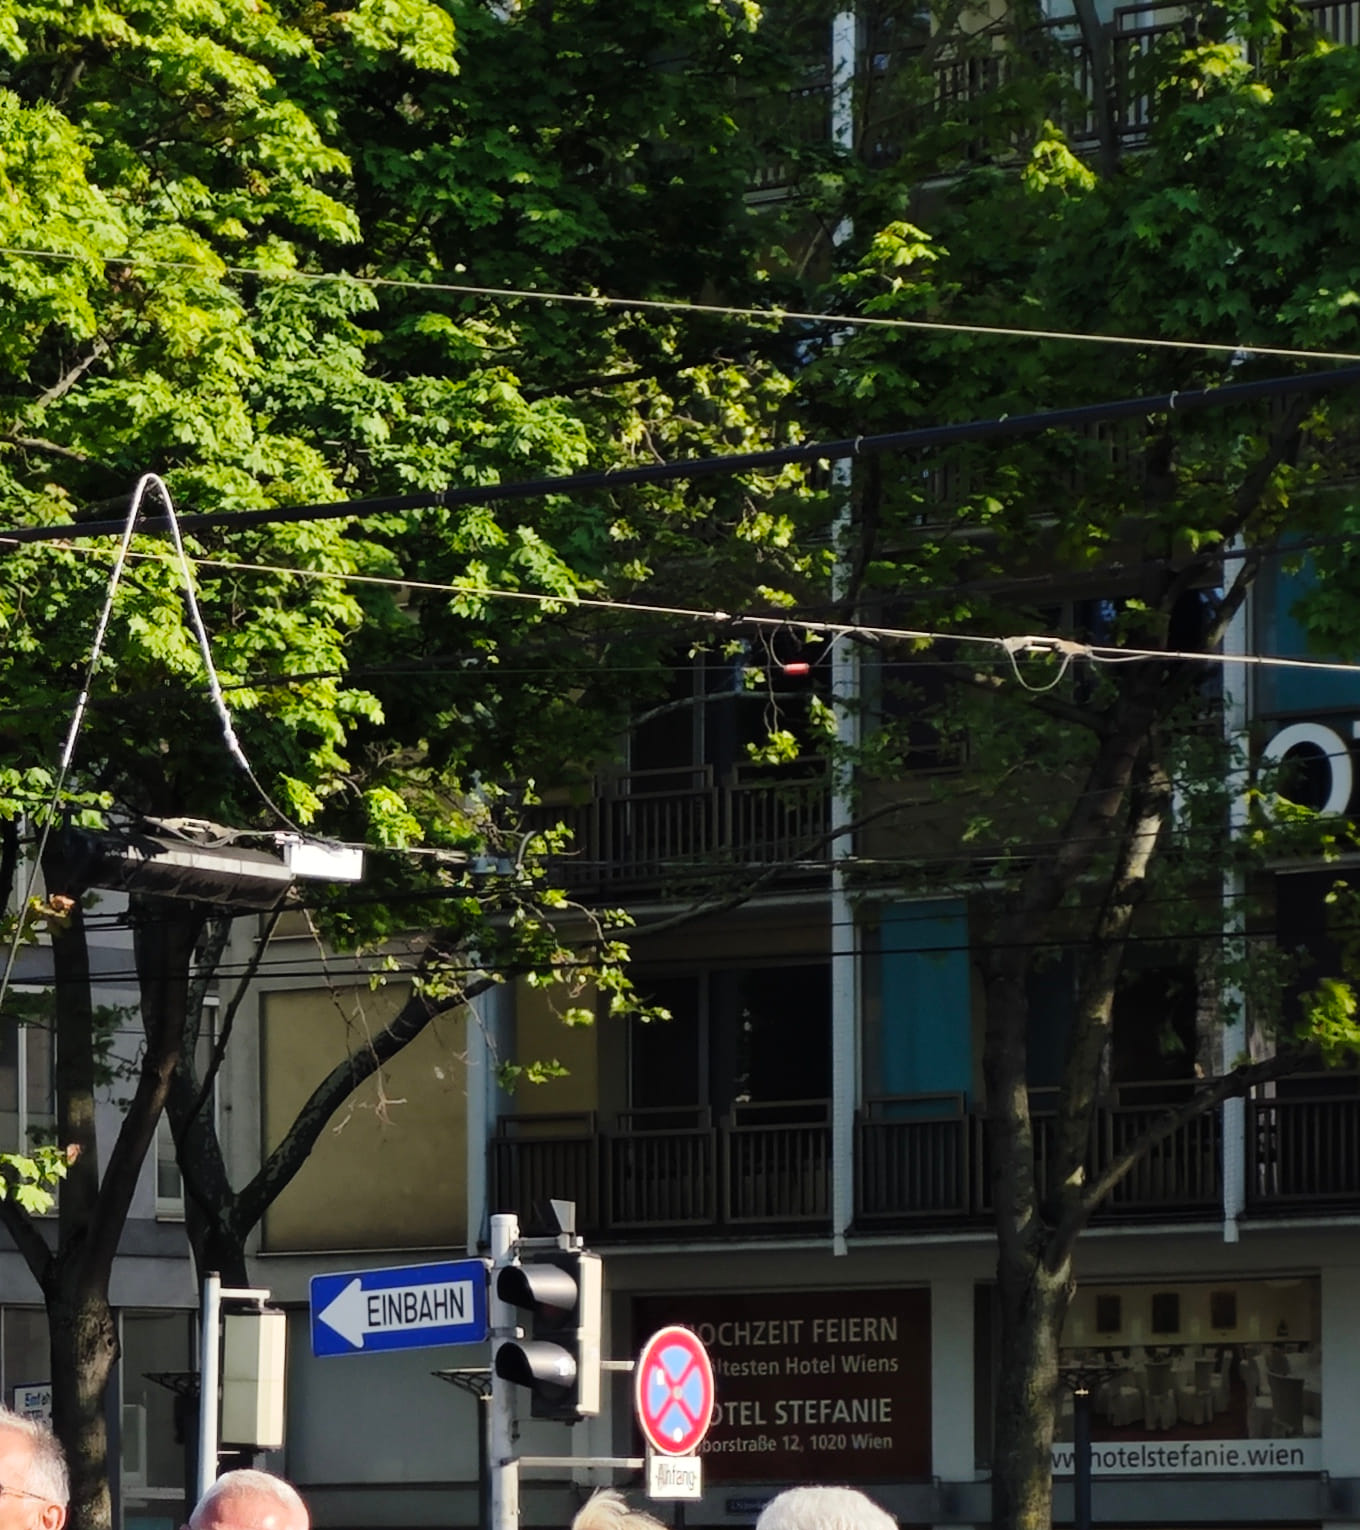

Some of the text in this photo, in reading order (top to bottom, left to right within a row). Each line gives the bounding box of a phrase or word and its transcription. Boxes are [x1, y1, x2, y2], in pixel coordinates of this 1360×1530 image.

[367, 1286, 465, 1327] EINBAHN
[691, 1317, 899, 1347] OCHZEIT FEIERN
[785, 1353, 836, 1376] Hotel
[841, 1353, 900, 1374] Wiens
[711, 1397, 892, 1427] OTEL STEFANIE
[700, 1434, 778, 1454] borstraße
[810, 1434, 847, 1450] 1020
[851, 1433, 893, 1450] Wien
[656, 1463, 696, 1492] Anfang
